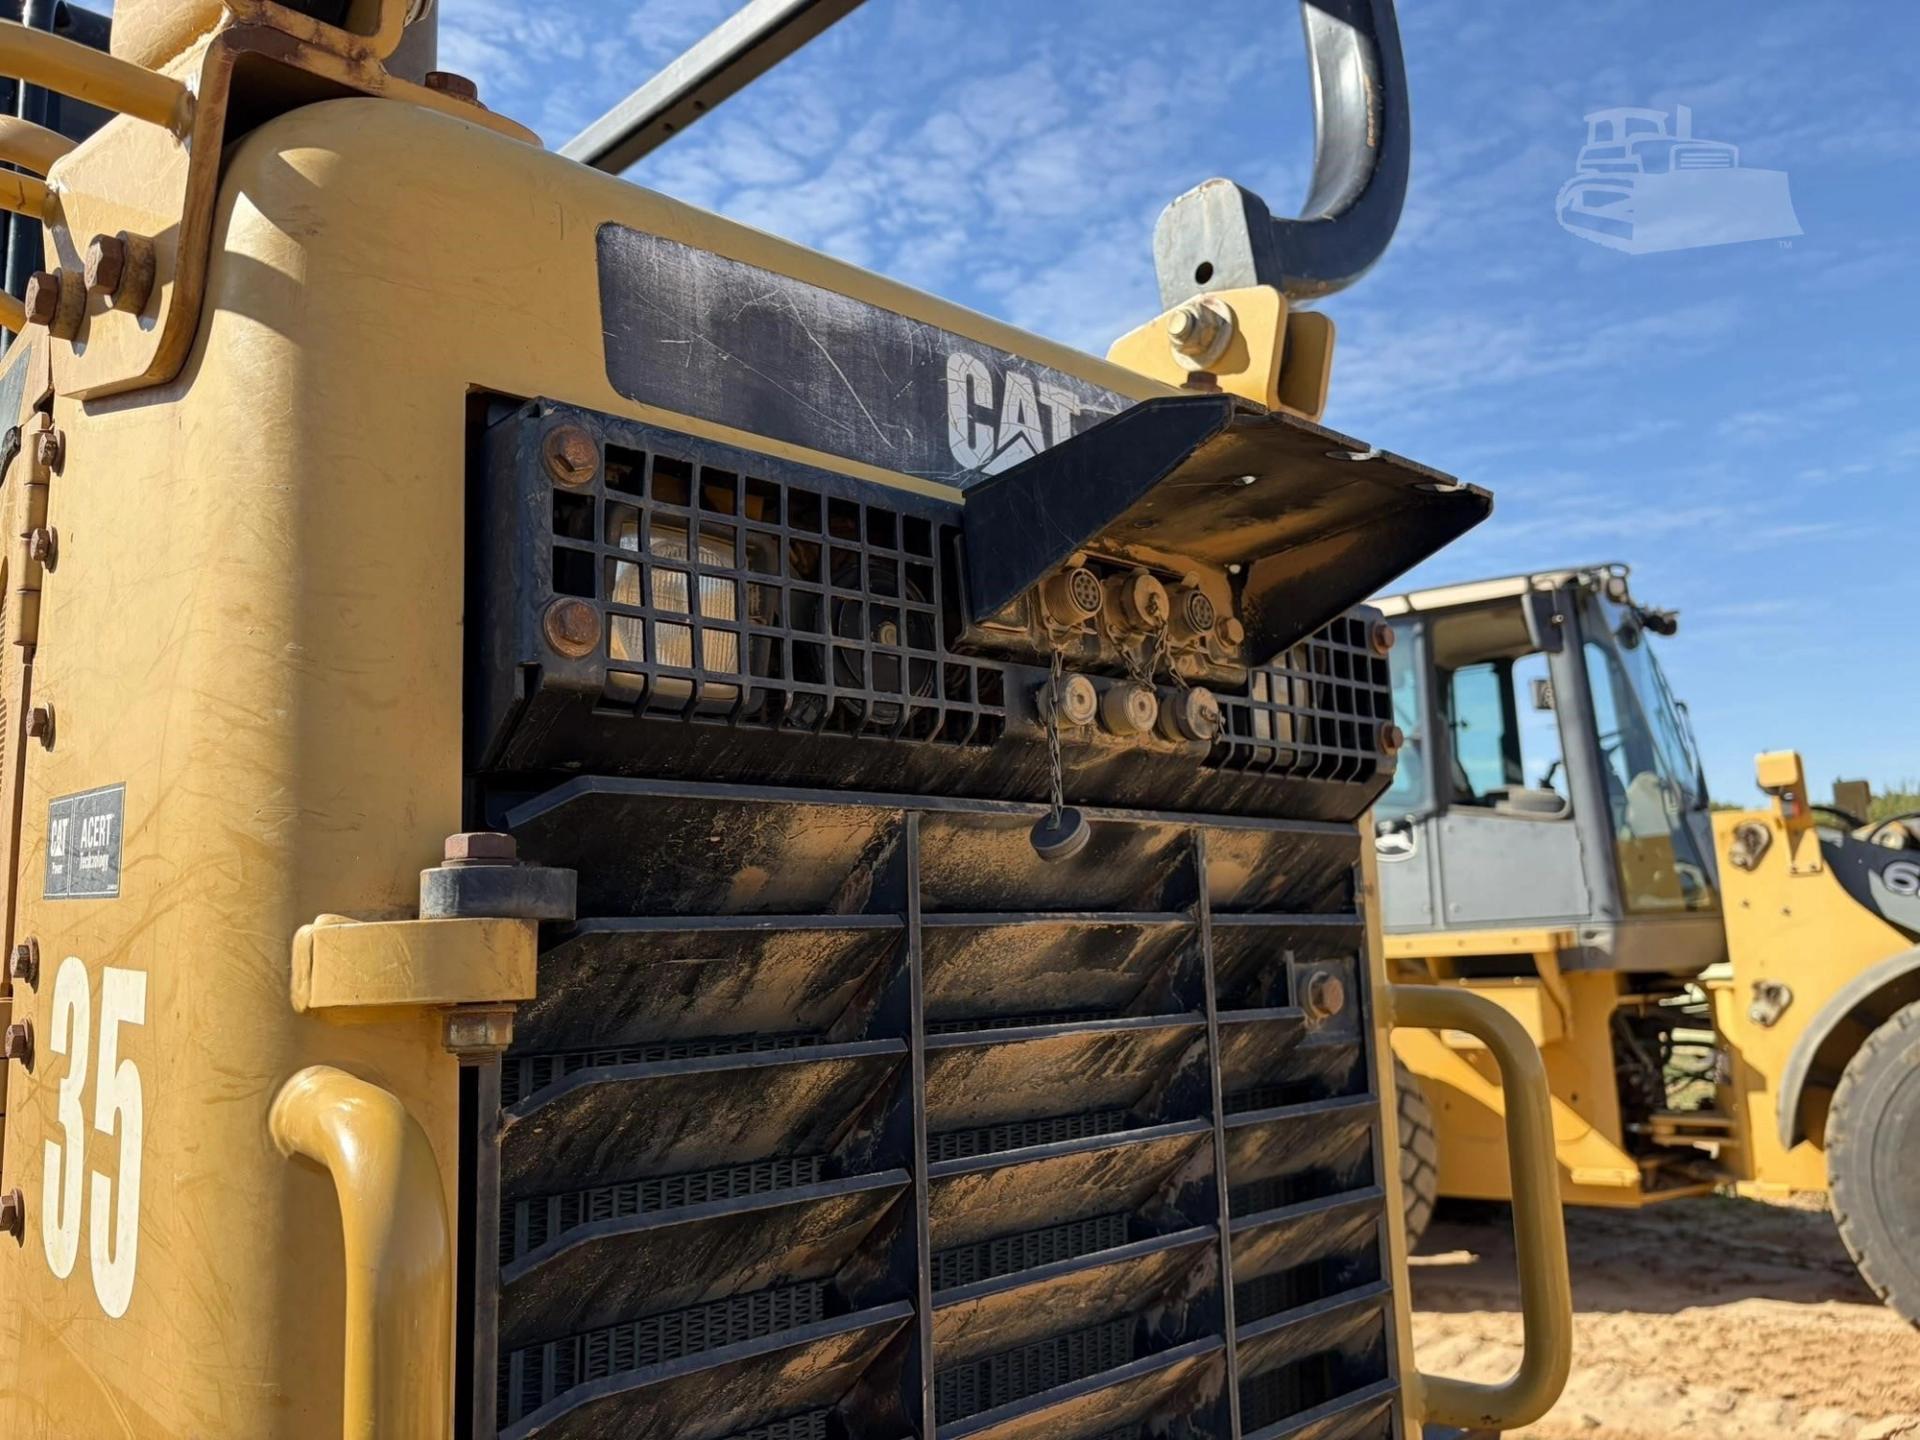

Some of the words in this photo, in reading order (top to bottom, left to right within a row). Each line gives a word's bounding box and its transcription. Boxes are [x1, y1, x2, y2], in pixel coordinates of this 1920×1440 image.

[946, 352, 1081, 476] CAT
[50, 817, 70, 857] CAT
[80, 814, 114, 848] ACERT
[1883, 861, 1920, 896] 6
[42, 955, 148, 1319] 35
